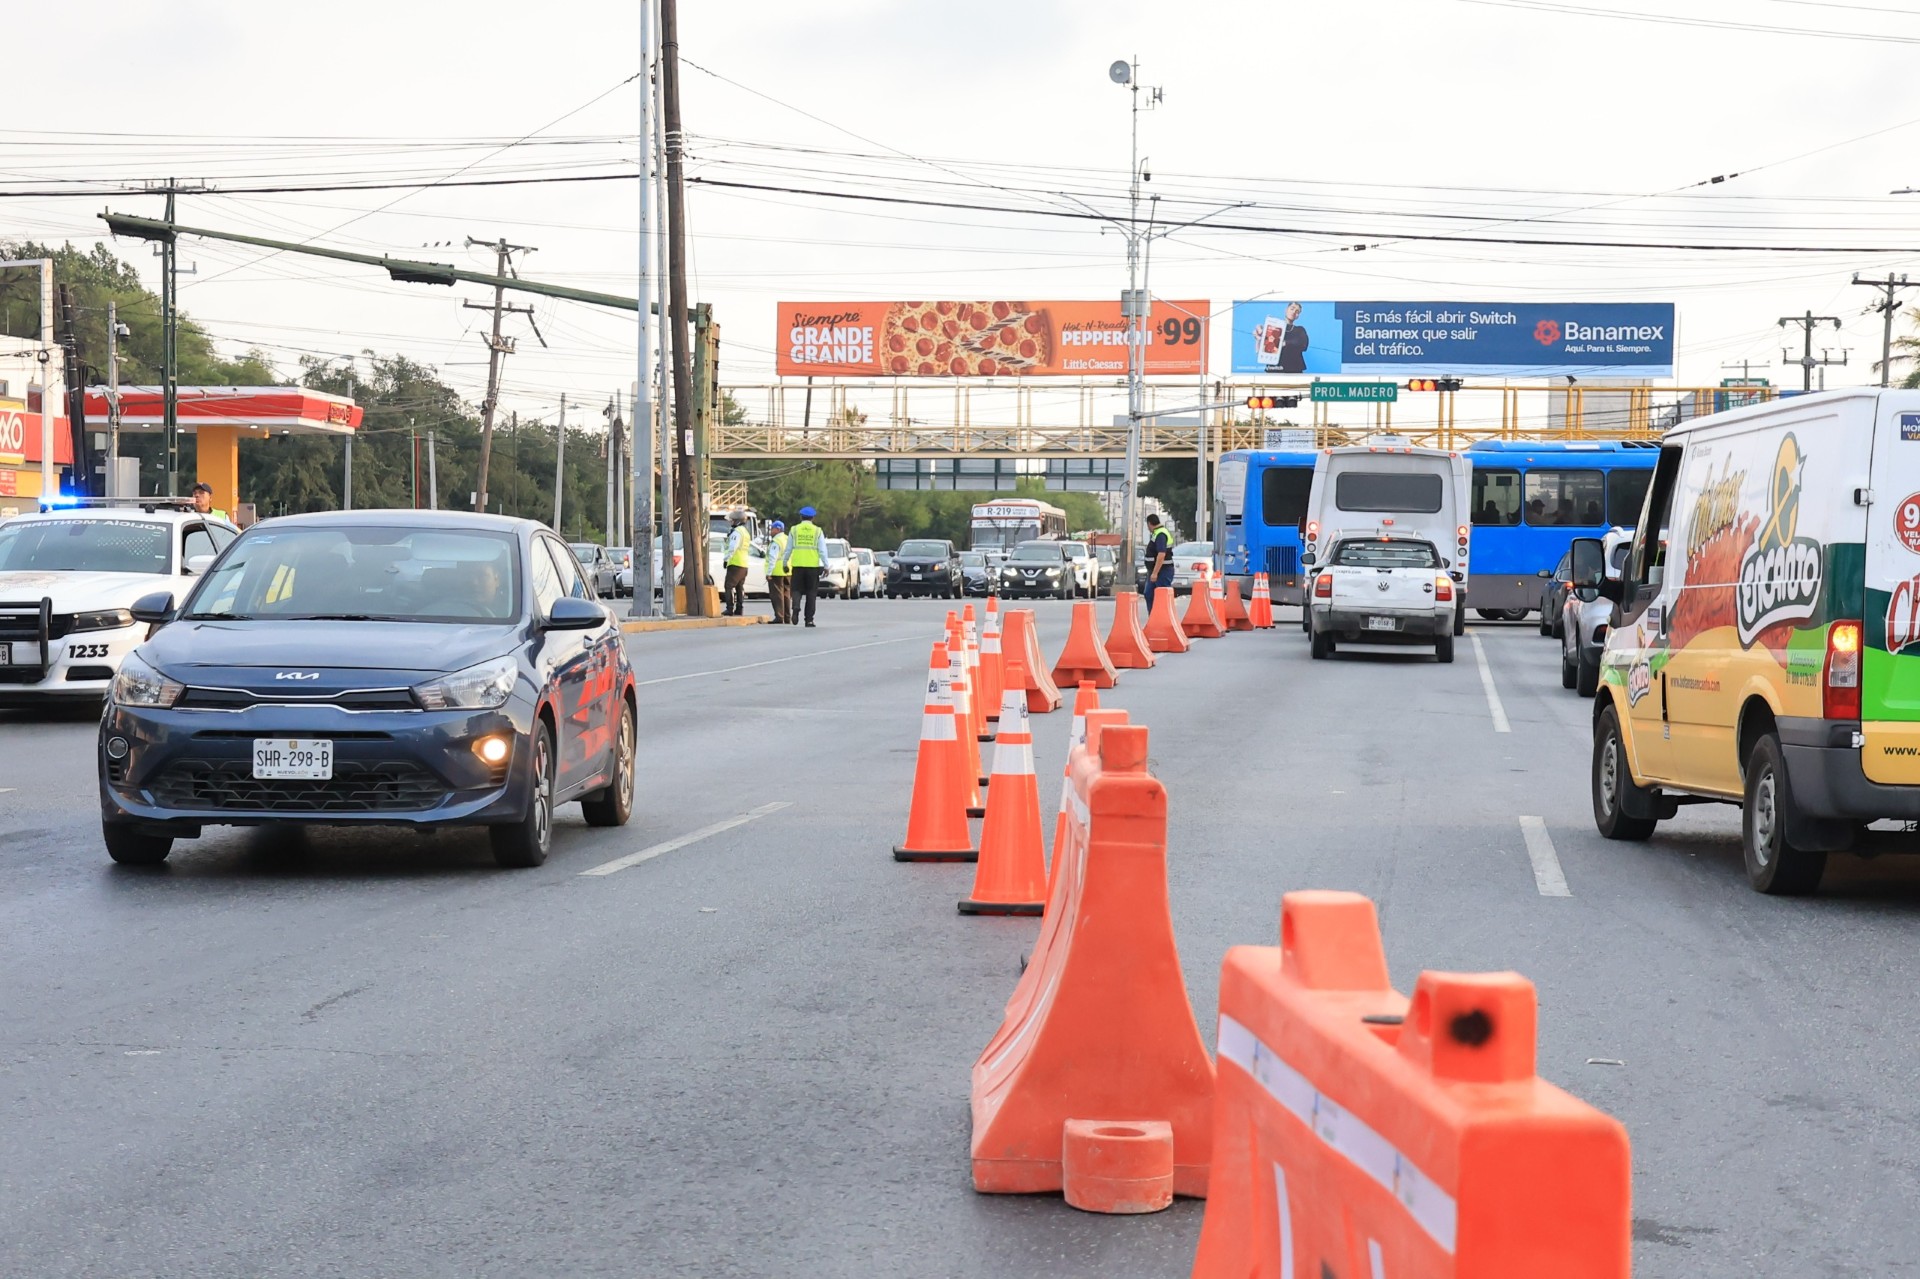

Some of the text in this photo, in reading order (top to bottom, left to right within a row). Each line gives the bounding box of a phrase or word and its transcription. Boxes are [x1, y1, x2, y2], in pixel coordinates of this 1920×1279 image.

[792, 312, 860, 332] Siempre
[1355, 310, 1517, 325] Es más fácil abrir Switch
[790, 327, 873, 345] GRANDE
[1157, 317, 1201, 345] $99
[1355, 326, 1478, 342] Banamex que salir
[1565, 321, 1664, 341] Banamex
[790, 345, 873, 363] GRANDE
[1354, 342, 1425, 356] del tráfico.
[1565, 344, 1652, 353] Aquí. Para ti. Siempre.
[1063, 358, 1088, 370] Little
[1088, 359, 1123, 370] Caesars
[1314, 386, 1394, 398] PROL. MADERO
[987, 508, 1012, 516] R-219
[69, 644, 109, 659] 1233
[275, 672, 320, 680] KIA
[257, 750, 330, 768] SHR-298-B
